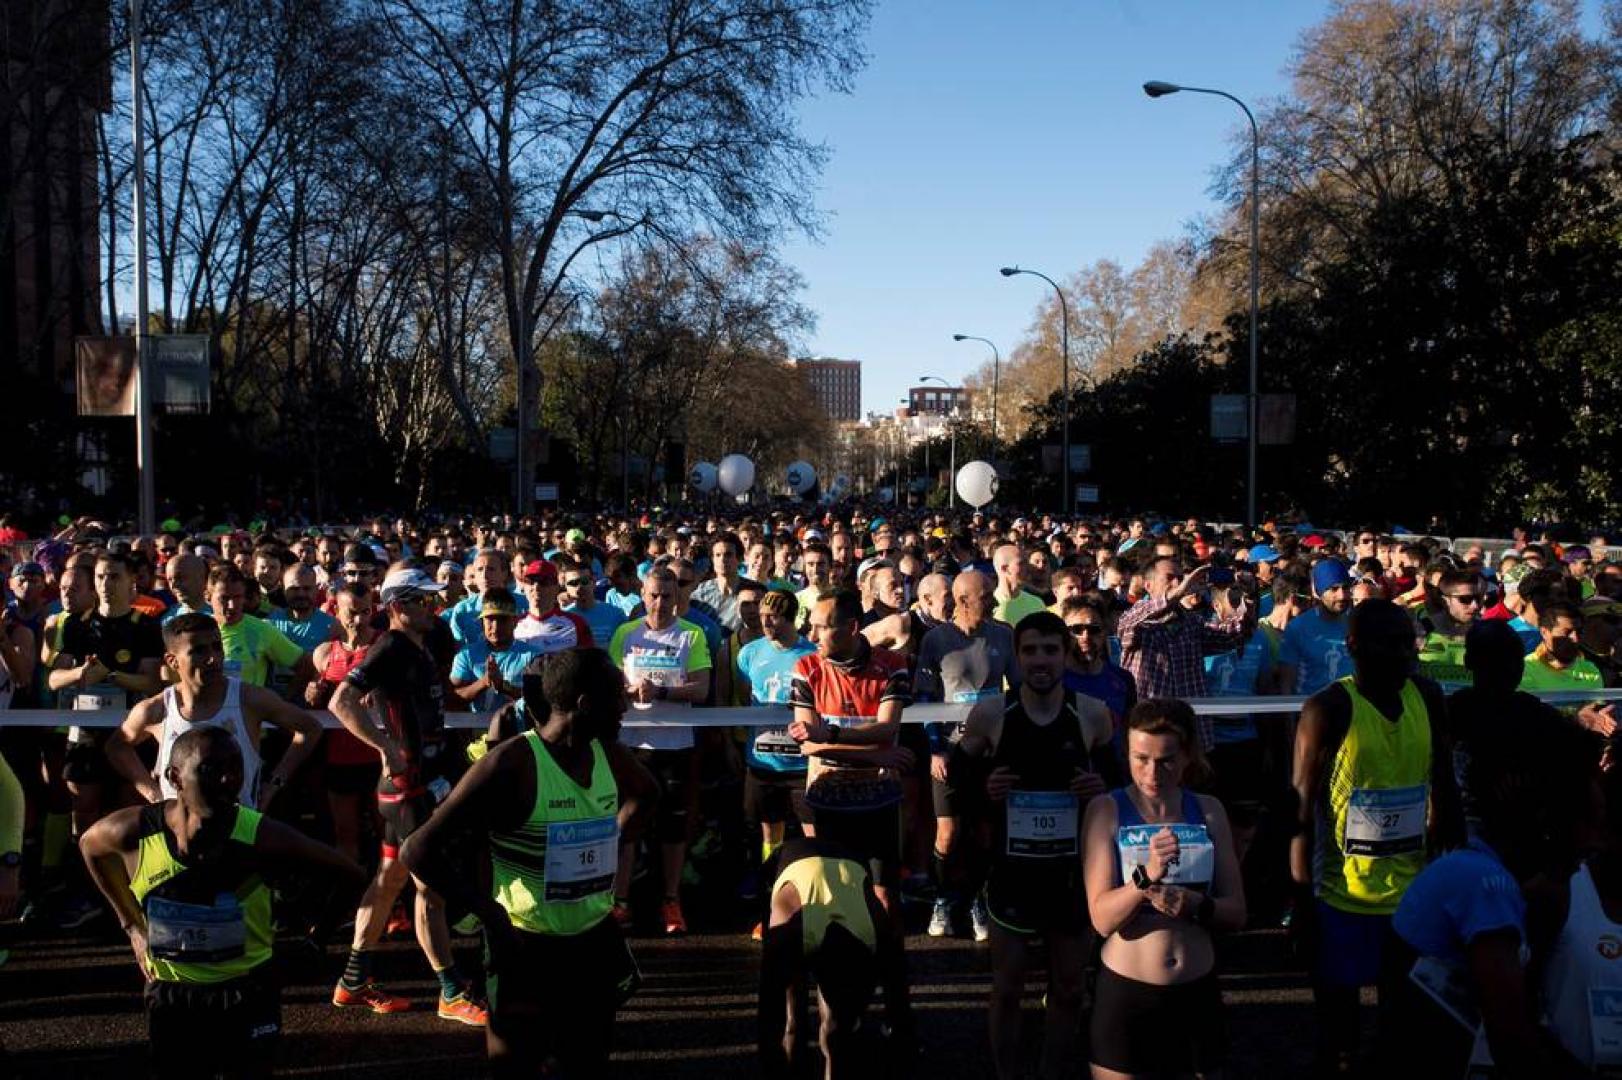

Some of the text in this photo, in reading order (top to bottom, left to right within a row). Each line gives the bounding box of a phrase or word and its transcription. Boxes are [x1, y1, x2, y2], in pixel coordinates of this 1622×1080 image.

[1032, 815, 1057, 829] 103
[1382, 814, 1401, 828] 27
[578, 849, 594, 866] 16
